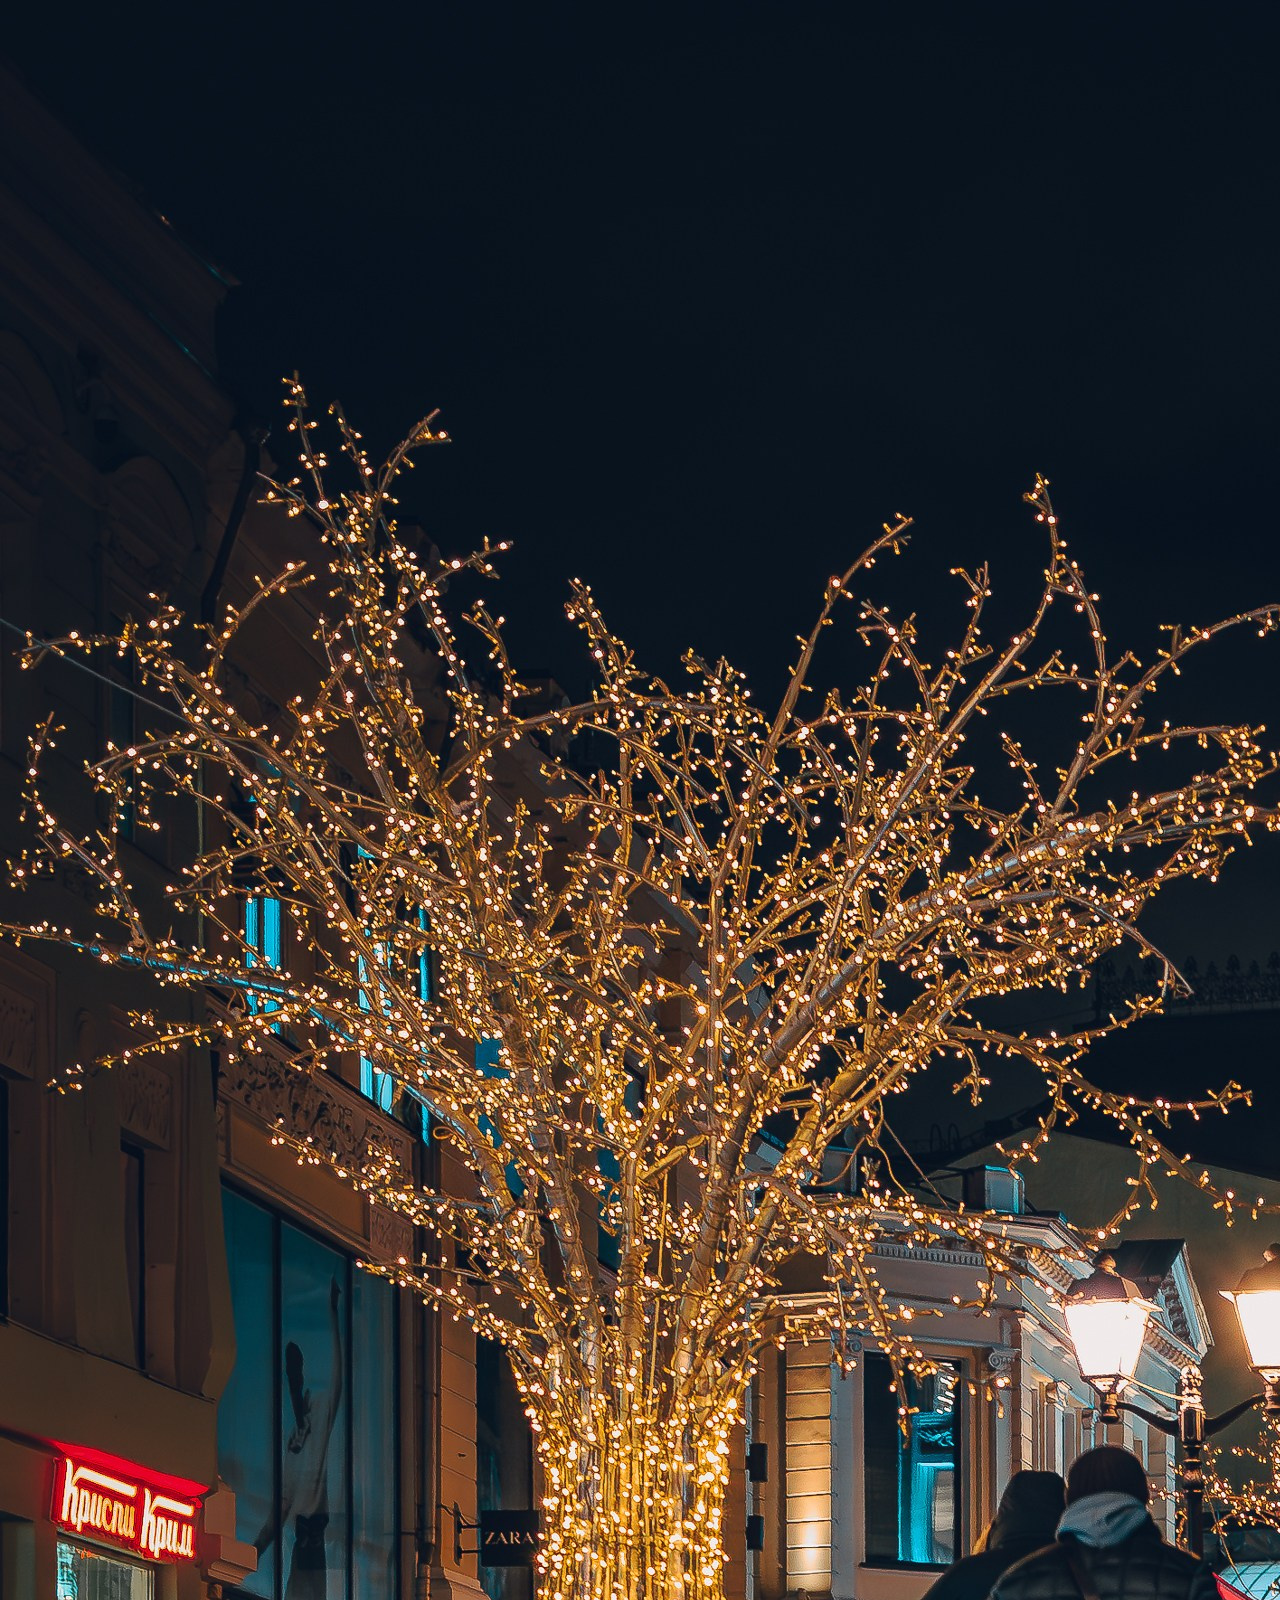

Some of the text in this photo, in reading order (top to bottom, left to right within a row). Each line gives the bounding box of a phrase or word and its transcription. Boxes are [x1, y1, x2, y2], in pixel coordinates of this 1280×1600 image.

[62, 1458, 195, 1558] Криспи Крим
[485, 1531, 534, 1545] ZARA
